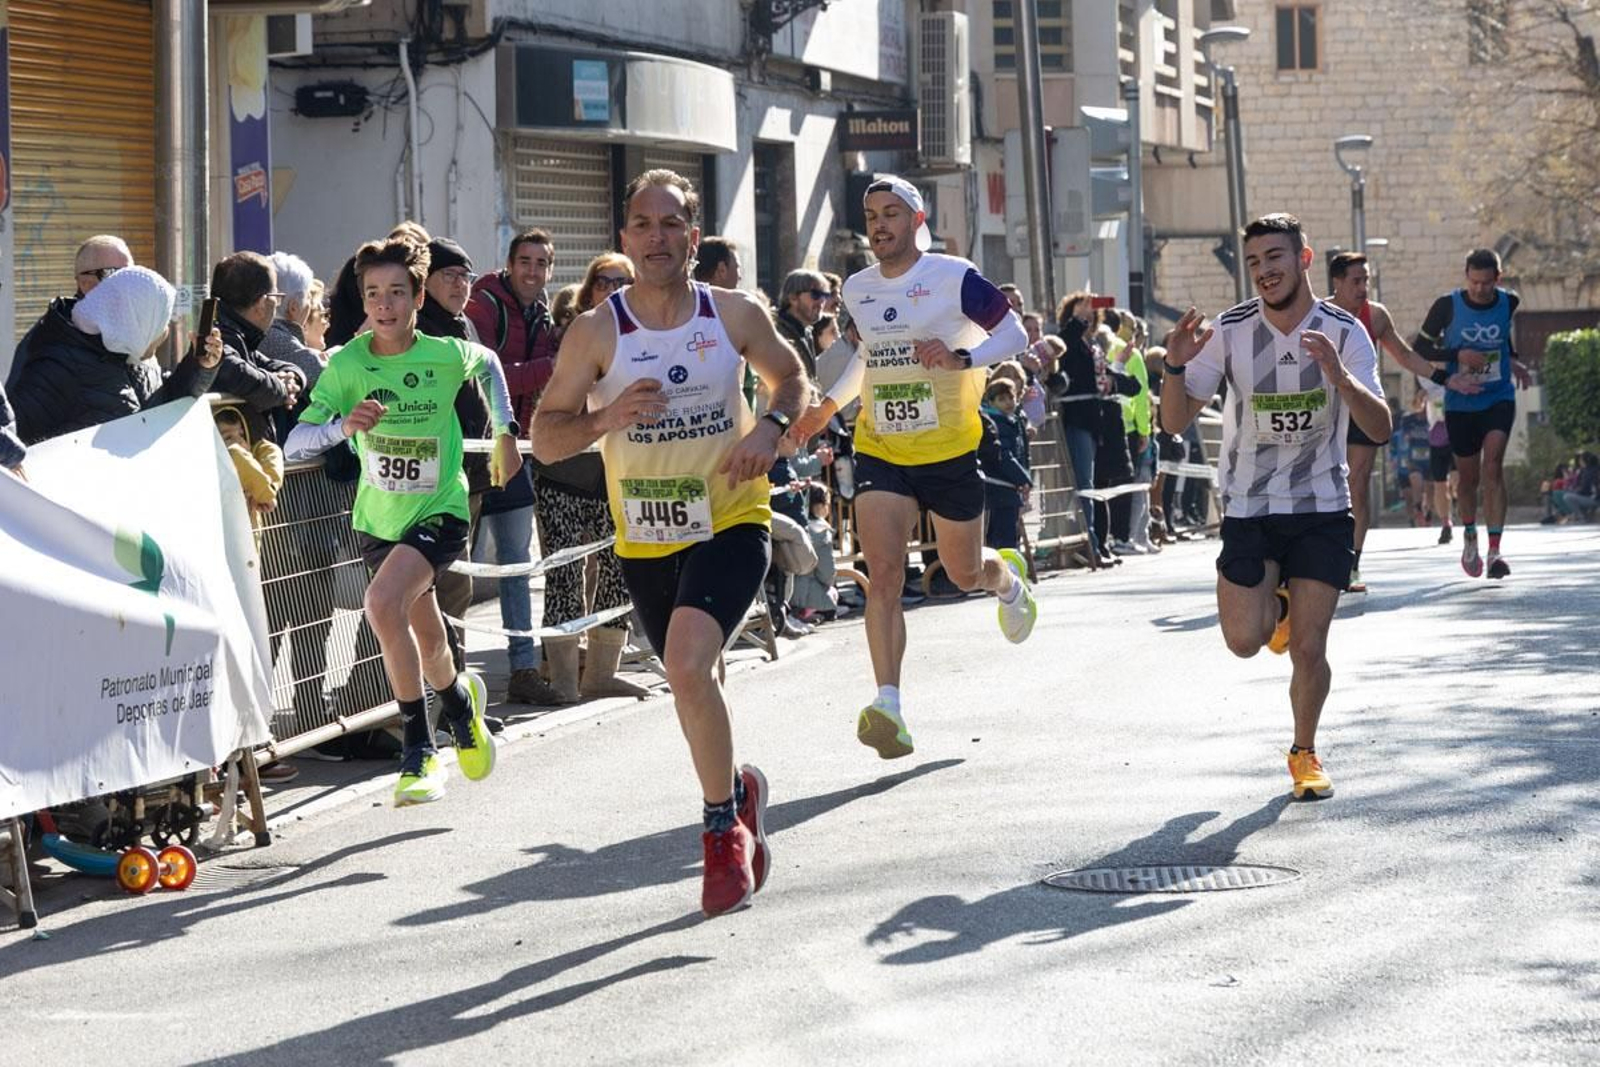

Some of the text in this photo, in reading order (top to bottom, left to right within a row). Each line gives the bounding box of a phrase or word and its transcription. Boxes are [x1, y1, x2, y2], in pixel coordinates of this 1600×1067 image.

[849, 118, 910, 133] Mahou
[880, 356, 920, 367] APÓSTO
[398, 399, 438, 413] Unicaja
[711, 408, 726, 421] DE
[885, 400, 920, 422] 635
[628, 417, 735, 444] LOS APÓSTOLES
[1271, 411, 1313, 432] 532
[378, 456, 421, 481] 396
[640, 499, 690, 527] 446
[101, 672, 157, 700] Patronato
[117, 699, 169, 725] Deportes
[172, 693, 187, 713] de
